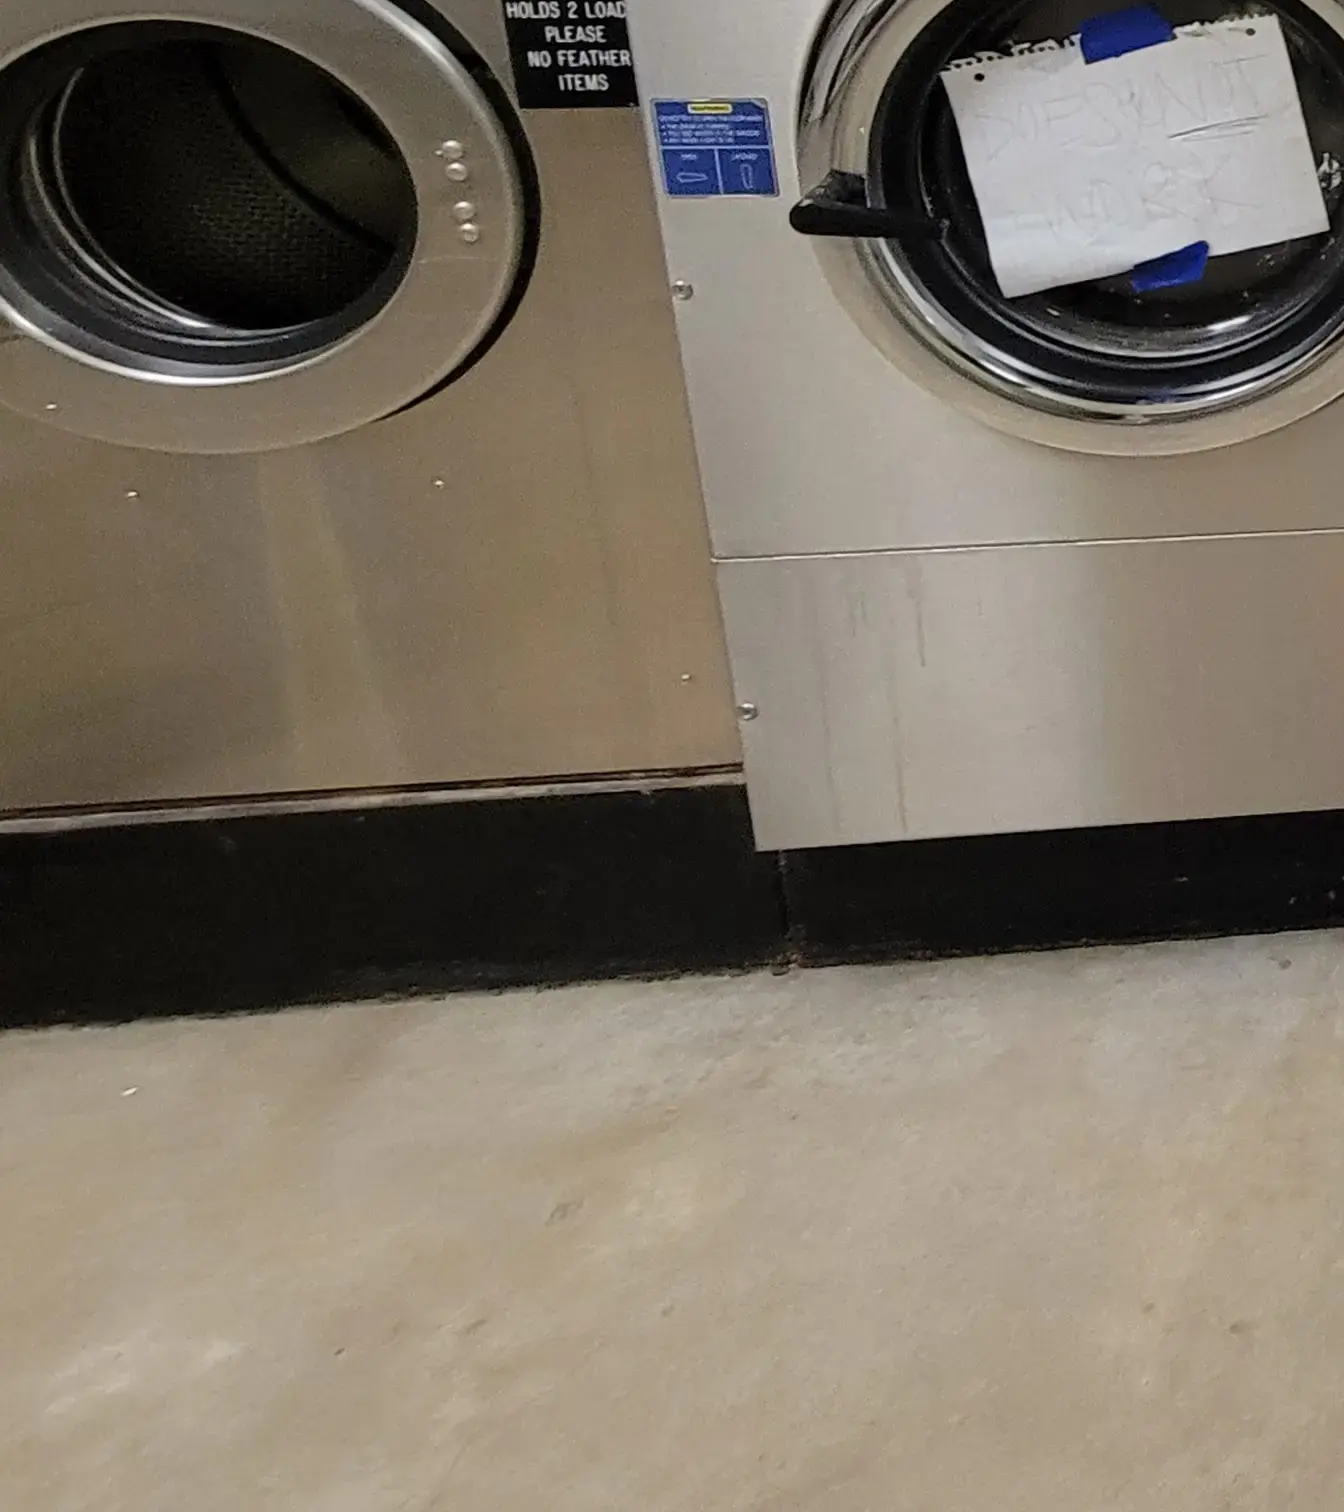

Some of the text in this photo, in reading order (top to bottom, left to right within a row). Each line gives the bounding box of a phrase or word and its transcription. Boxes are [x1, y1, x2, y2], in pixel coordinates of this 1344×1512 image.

[505, 1, 627, 19] HOLDS 2 LOAD
[544, 25, 607, 43] PLEASE
[527, 49, 632, 67] NO FEATHER
[558, 74, 610, 91] ITEMS
